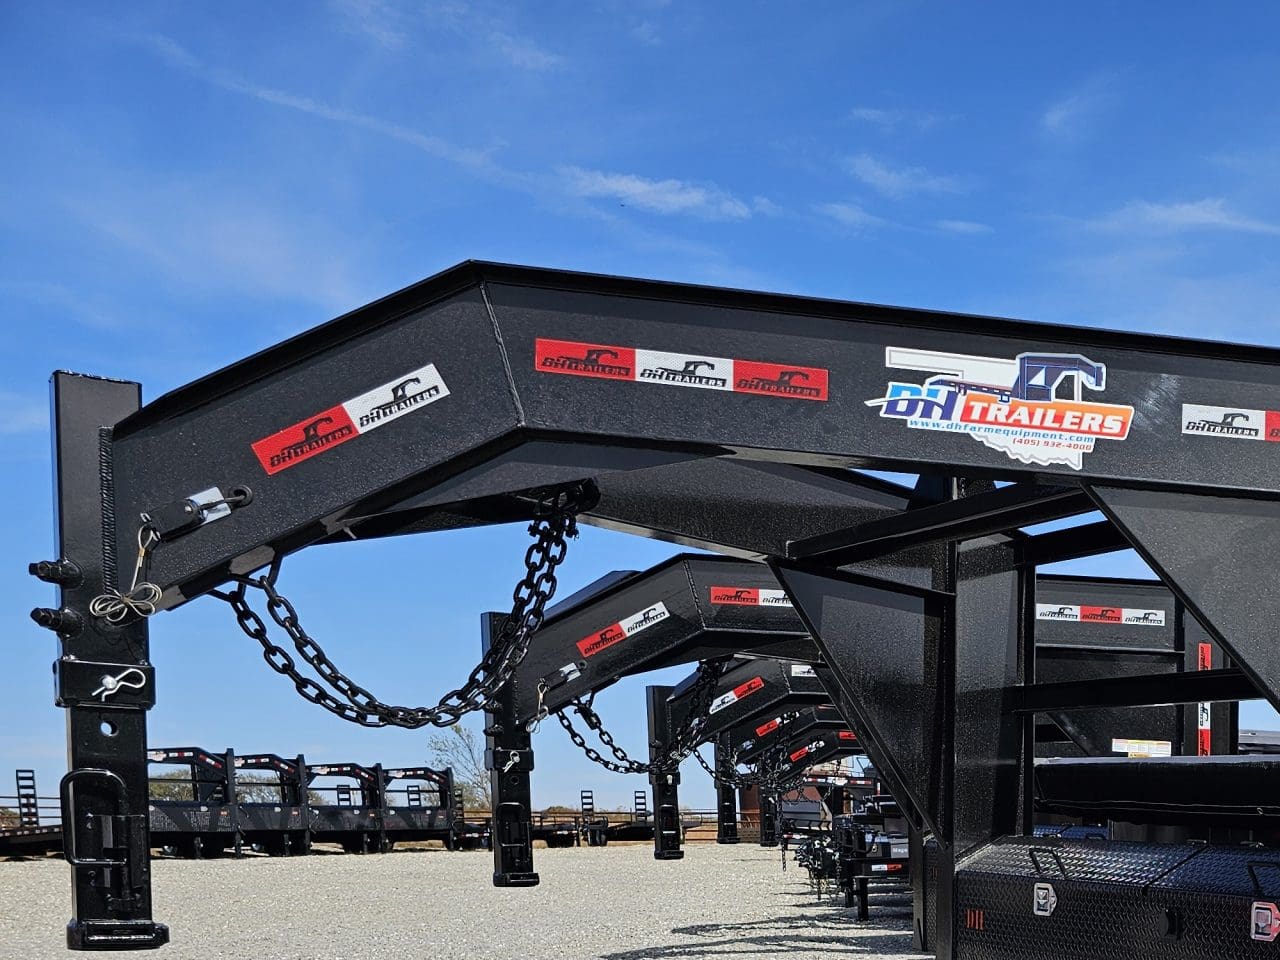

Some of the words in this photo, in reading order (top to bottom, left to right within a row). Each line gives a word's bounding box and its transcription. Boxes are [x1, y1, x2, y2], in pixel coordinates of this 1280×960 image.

[884, 385, 959, 420] DH
[969, 401, 1123, 434] TRAILERS
[909, 420, 1095, 443] www.dhfarmequipment.com
[1013, 438, 1040, 447] (405)
